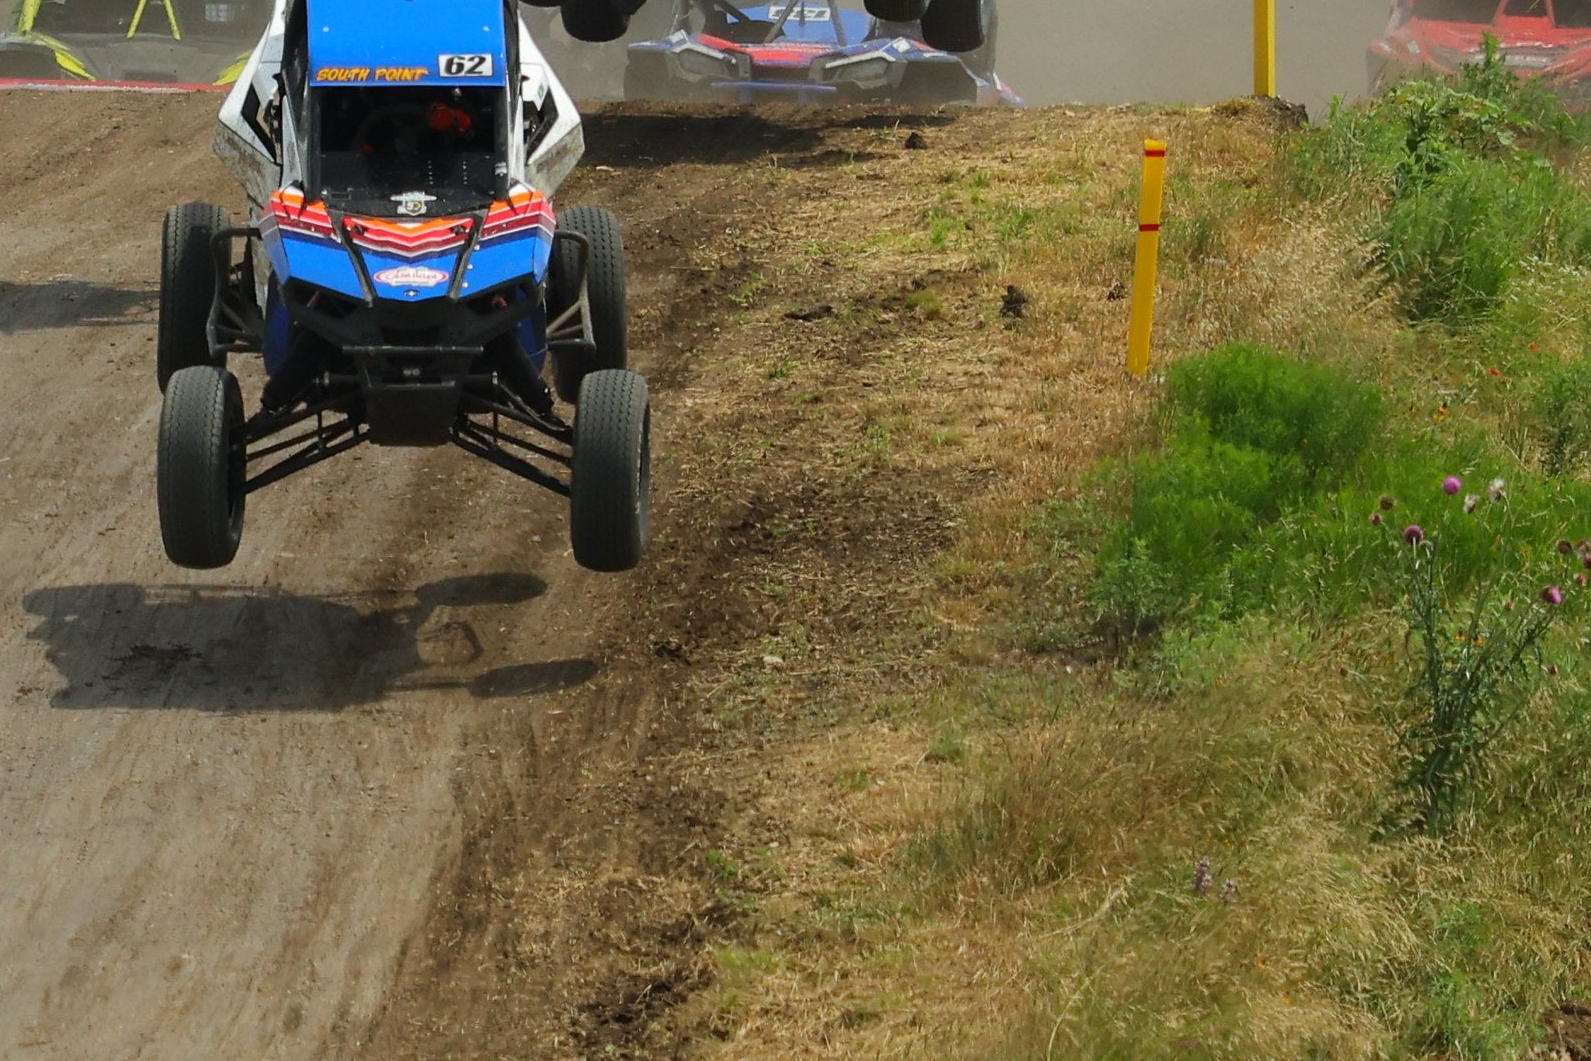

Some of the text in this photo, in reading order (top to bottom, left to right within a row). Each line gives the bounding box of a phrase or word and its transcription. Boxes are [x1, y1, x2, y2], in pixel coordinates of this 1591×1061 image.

[316, 67, 430, 82] SOUTH POINT
[444, 55, 487, 76] 62
